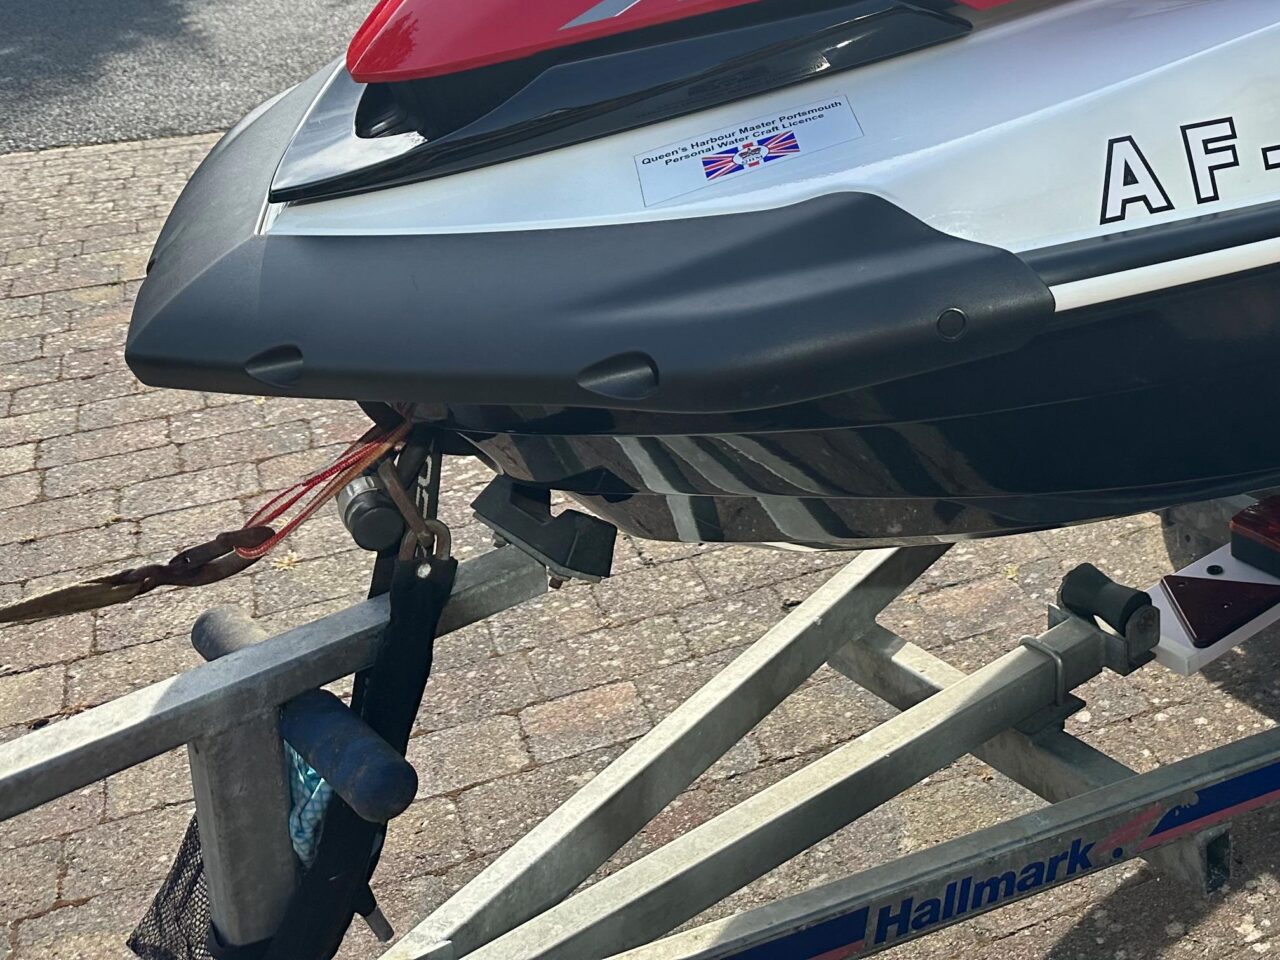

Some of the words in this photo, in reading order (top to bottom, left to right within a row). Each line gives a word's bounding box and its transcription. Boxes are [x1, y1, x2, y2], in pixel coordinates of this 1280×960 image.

[641, 146, 688, 165] Queen's
[690, 130, 736, 150] Harbour
[738, 119, 776, 135] Master
[778, 101, 842, 123] Portsmouth
[664, 145, 715, 166] Personal
[717, 135, 750, 149] Water
[752, 125, 779, 138] Craft
[781, 113, 824, 130] Licence
[874, 837, 1096, 946] Hallmark
